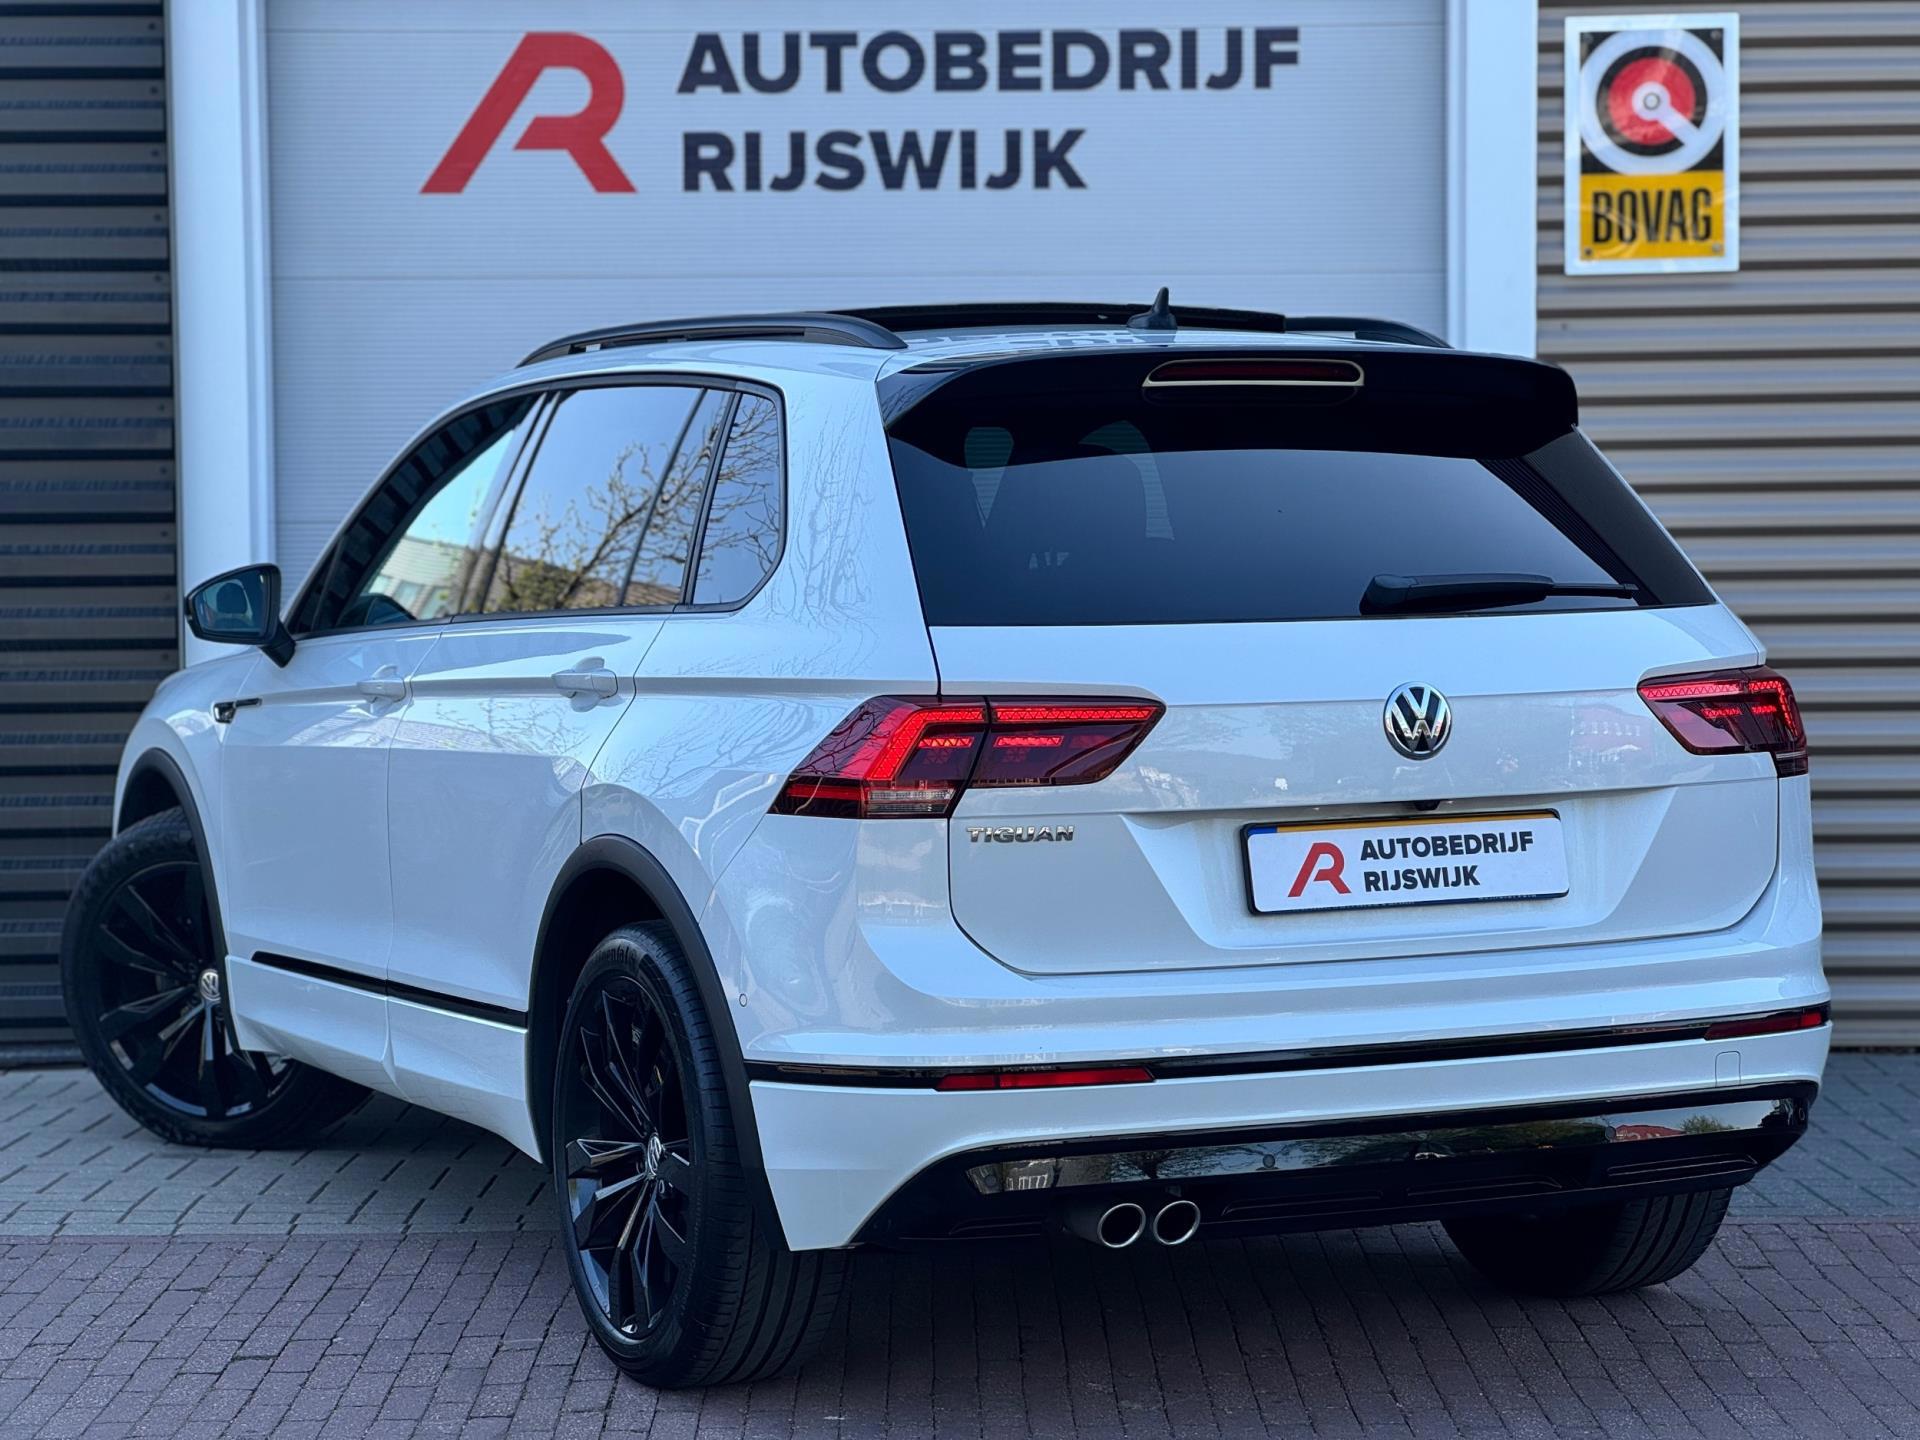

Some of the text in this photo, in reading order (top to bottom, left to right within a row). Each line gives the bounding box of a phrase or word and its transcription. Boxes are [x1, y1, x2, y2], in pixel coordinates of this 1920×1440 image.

[676, 26, 1300, 94] AUTOBEDRIJF
[681, 128, 1088, 193] RIJSWIJK
[1591, 188, 1713, 244] BOVAG
[966, 825, 1075, 844] TIGUAN
[1359, 830, 1534, 861] AUTOBEDRIJF
[1363, 864, 1481, 893] RIJSWIJK
